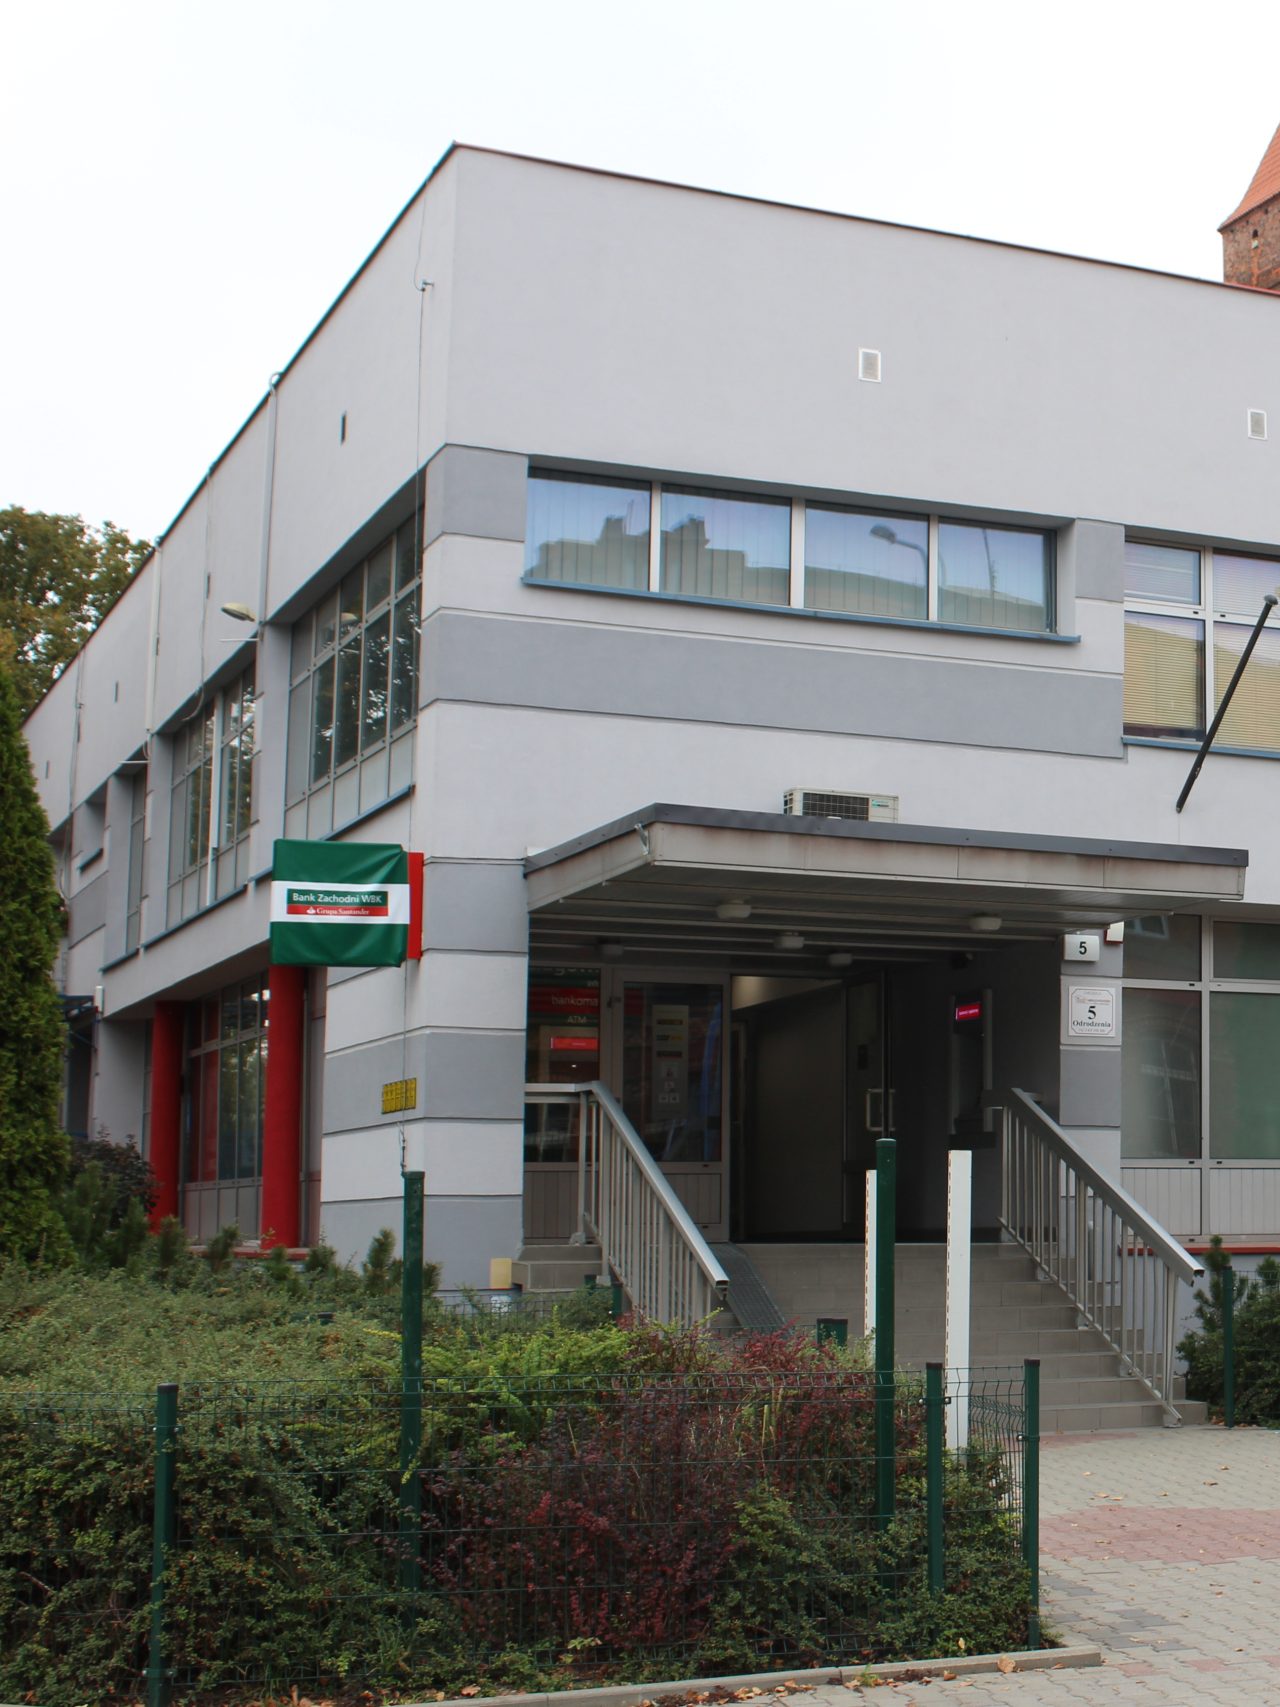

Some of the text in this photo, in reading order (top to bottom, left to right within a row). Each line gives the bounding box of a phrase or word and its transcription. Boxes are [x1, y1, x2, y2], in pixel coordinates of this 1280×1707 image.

[292, 892, 382, 904] Bank Zachodni WBK
[337, 907, 369, 915] Santander
[1079, 941, 1087, 955] 5
[552, 994, 599, 1007] bankoma
[1088, 1006, 1096, 1020] 5
[567, 1015, 587, 1024] ATM
[1072, 1020, 1111, 1028] Odrodzenia
